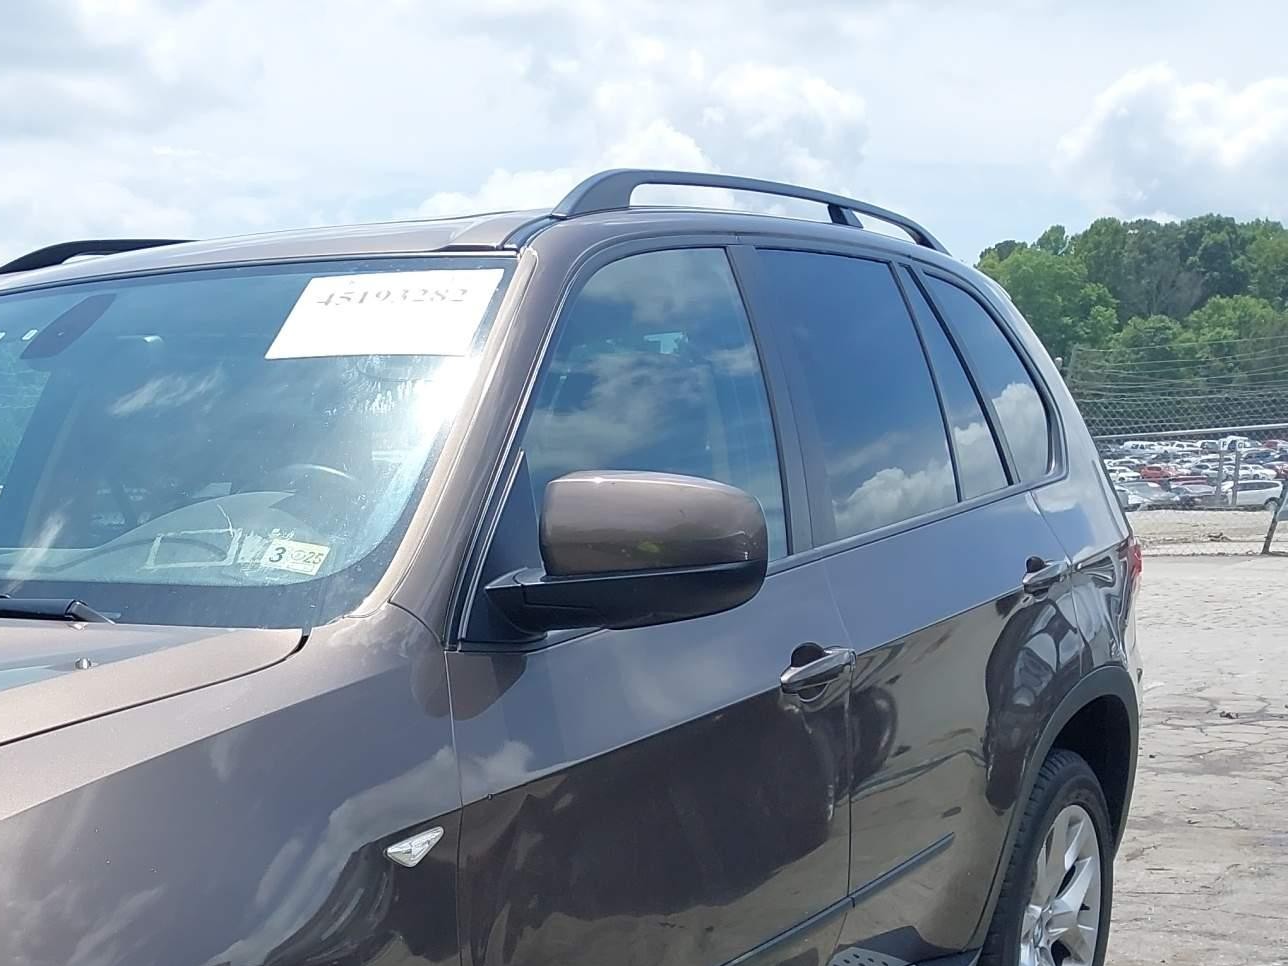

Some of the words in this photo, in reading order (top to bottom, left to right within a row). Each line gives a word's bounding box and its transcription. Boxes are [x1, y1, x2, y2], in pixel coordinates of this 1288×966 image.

[314, 288, 469, 307] 45193282
[268, 546, 287, 563] 3
[303, 551, 324, 565] 25
